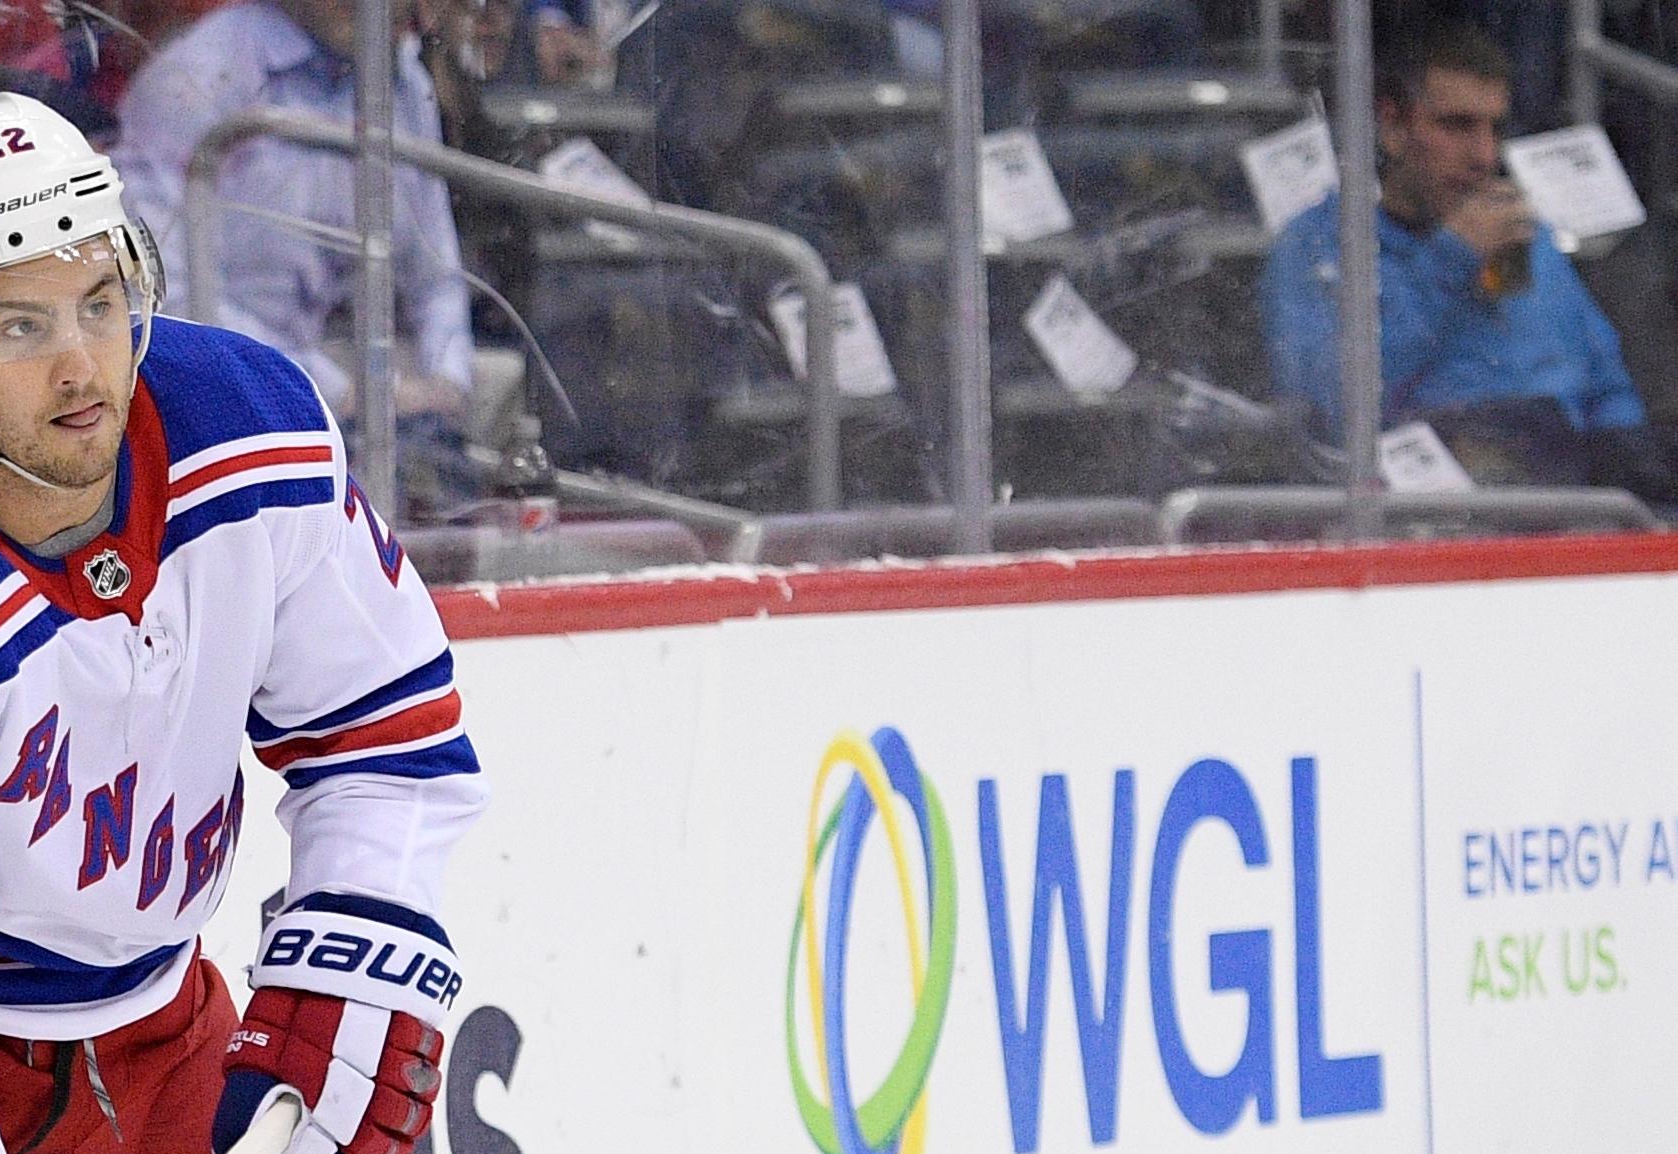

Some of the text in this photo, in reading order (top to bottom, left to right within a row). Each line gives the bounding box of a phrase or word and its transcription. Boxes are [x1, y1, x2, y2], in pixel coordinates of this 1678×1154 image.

[100, 561, 116, 590] NHL
[1464, 820, 1629, 899] ENERGY
[261, 928, 463, 1011] BAUER
[1469, 926, 1628, 1002] ASK US.
